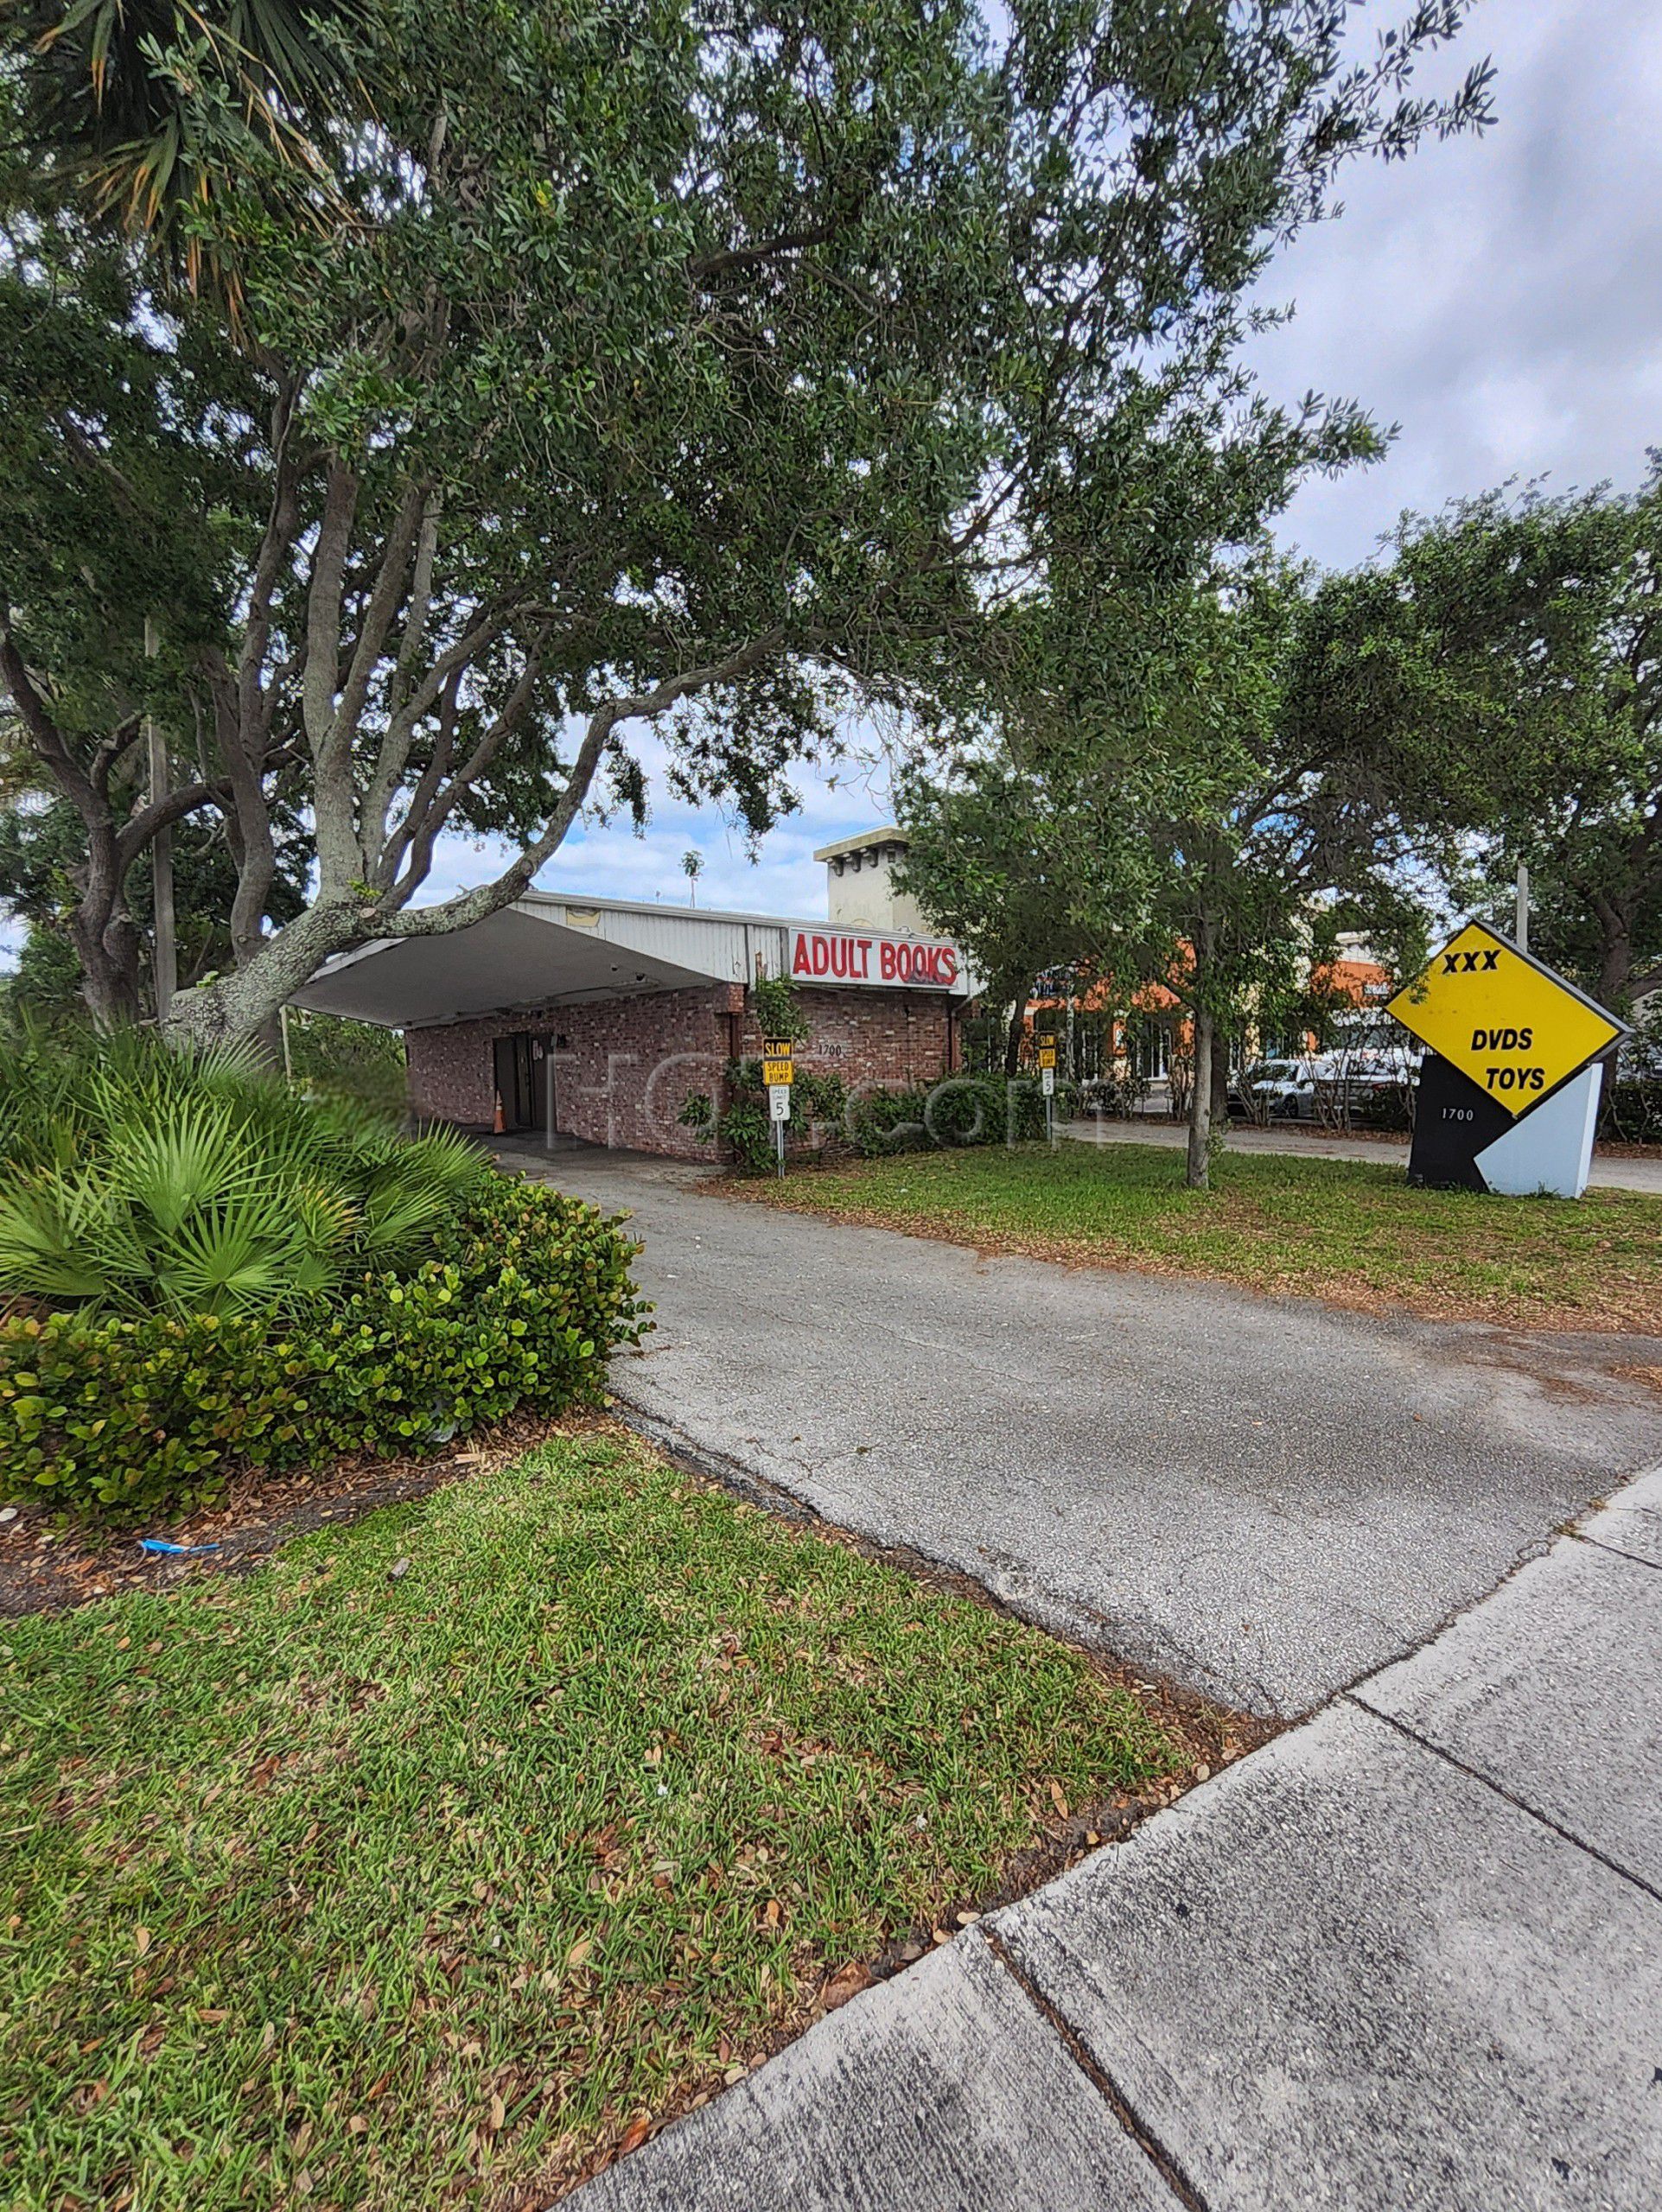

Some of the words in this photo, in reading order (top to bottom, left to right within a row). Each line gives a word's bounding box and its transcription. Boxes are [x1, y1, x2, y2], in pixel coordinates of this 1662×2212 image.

[793, 933, 872, 979] ADULT
[880, 942, 958, 985] BOOKS
[1442, 950, 1501, 975] XXX
[1470, 1027, 1533, 1051] DVDS
[765, 1042, 791, 1057] SLOW
[818, 1044, 841, 1057] 1700
[767, 1061, 789, 1071] SPEED
[768, 1072, 789, 1083] BUMP
[1485, 1068, 1545, 1090] TOYS
[1046, 1081, 1051, 1092] 5
[776, 1102, 784, 1116] 5
[1442, 1108, 1474, 1121] 1700
